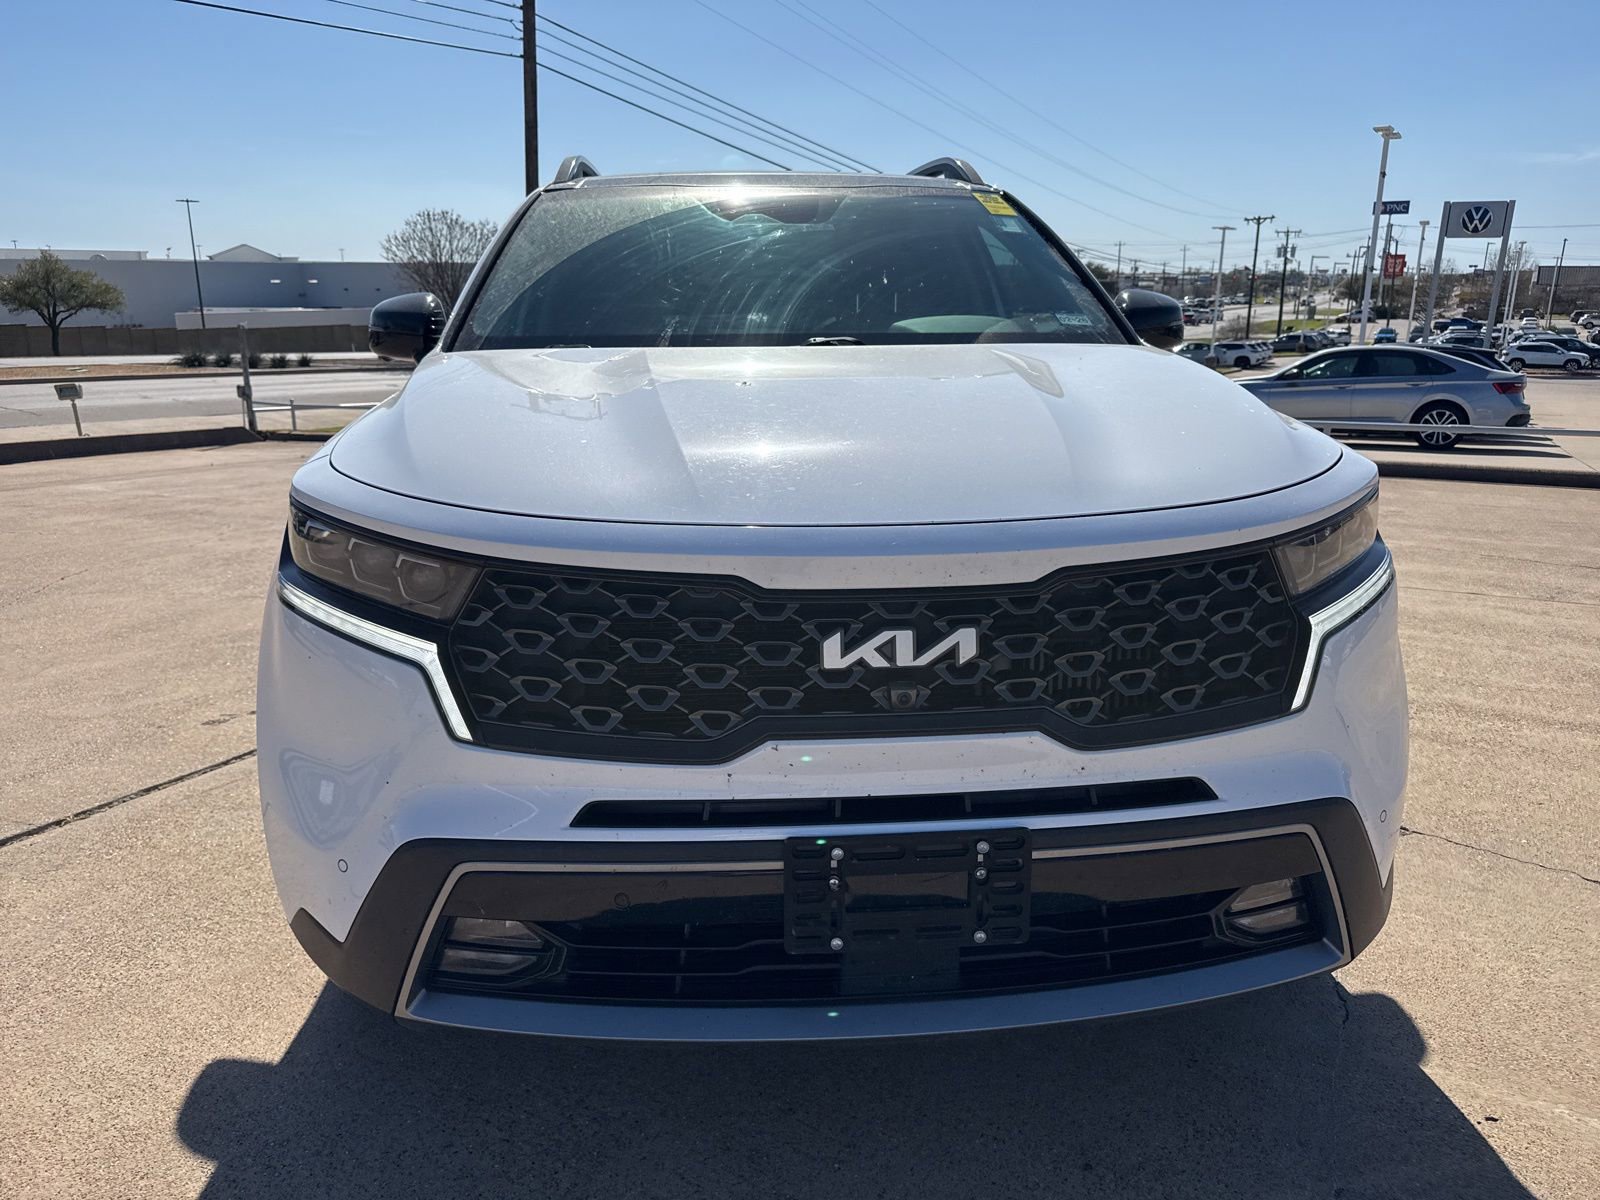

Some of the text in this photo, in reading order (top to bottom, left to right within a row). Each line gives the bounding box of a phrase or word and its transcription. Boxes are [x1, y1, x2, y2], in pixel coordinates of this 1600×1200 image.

[1386, 203, 1408, 212] PNC
[1462, 205, 1493, 233] VW
[823, 627, 977, 669] KIA
